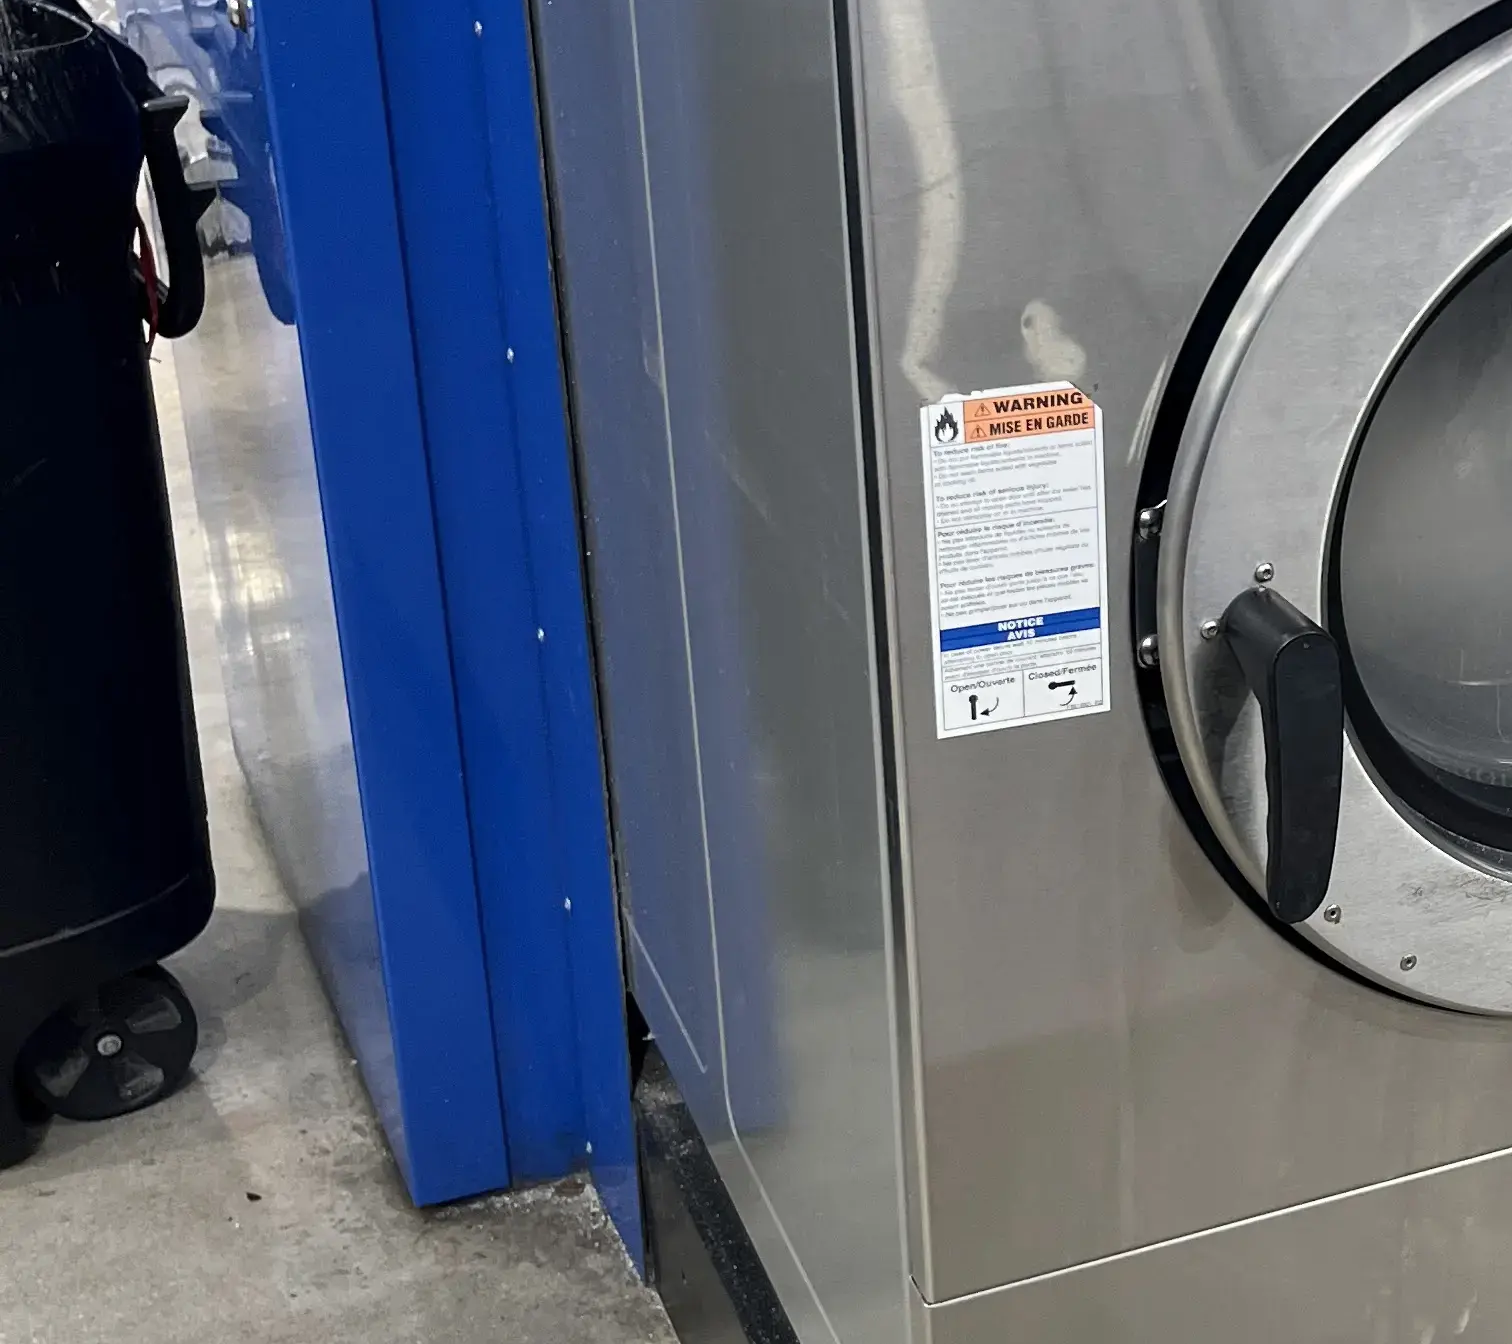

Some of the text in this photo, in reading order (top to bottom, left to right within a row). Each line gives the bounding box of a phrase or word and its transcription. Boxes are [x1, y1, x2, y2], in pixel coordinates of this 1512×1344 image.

[992, 391, 1084, 414] WARNING
[989, 412, 1089, 436] MISE EN GARDE
[997, 616, 1045, 632] NOTICE
[1007, 628, 1037, 641] AVIS
[1028, 663, 1097, 681] Closed/Fermée
[950, 676, 1016, 694] Open/Ouverte
